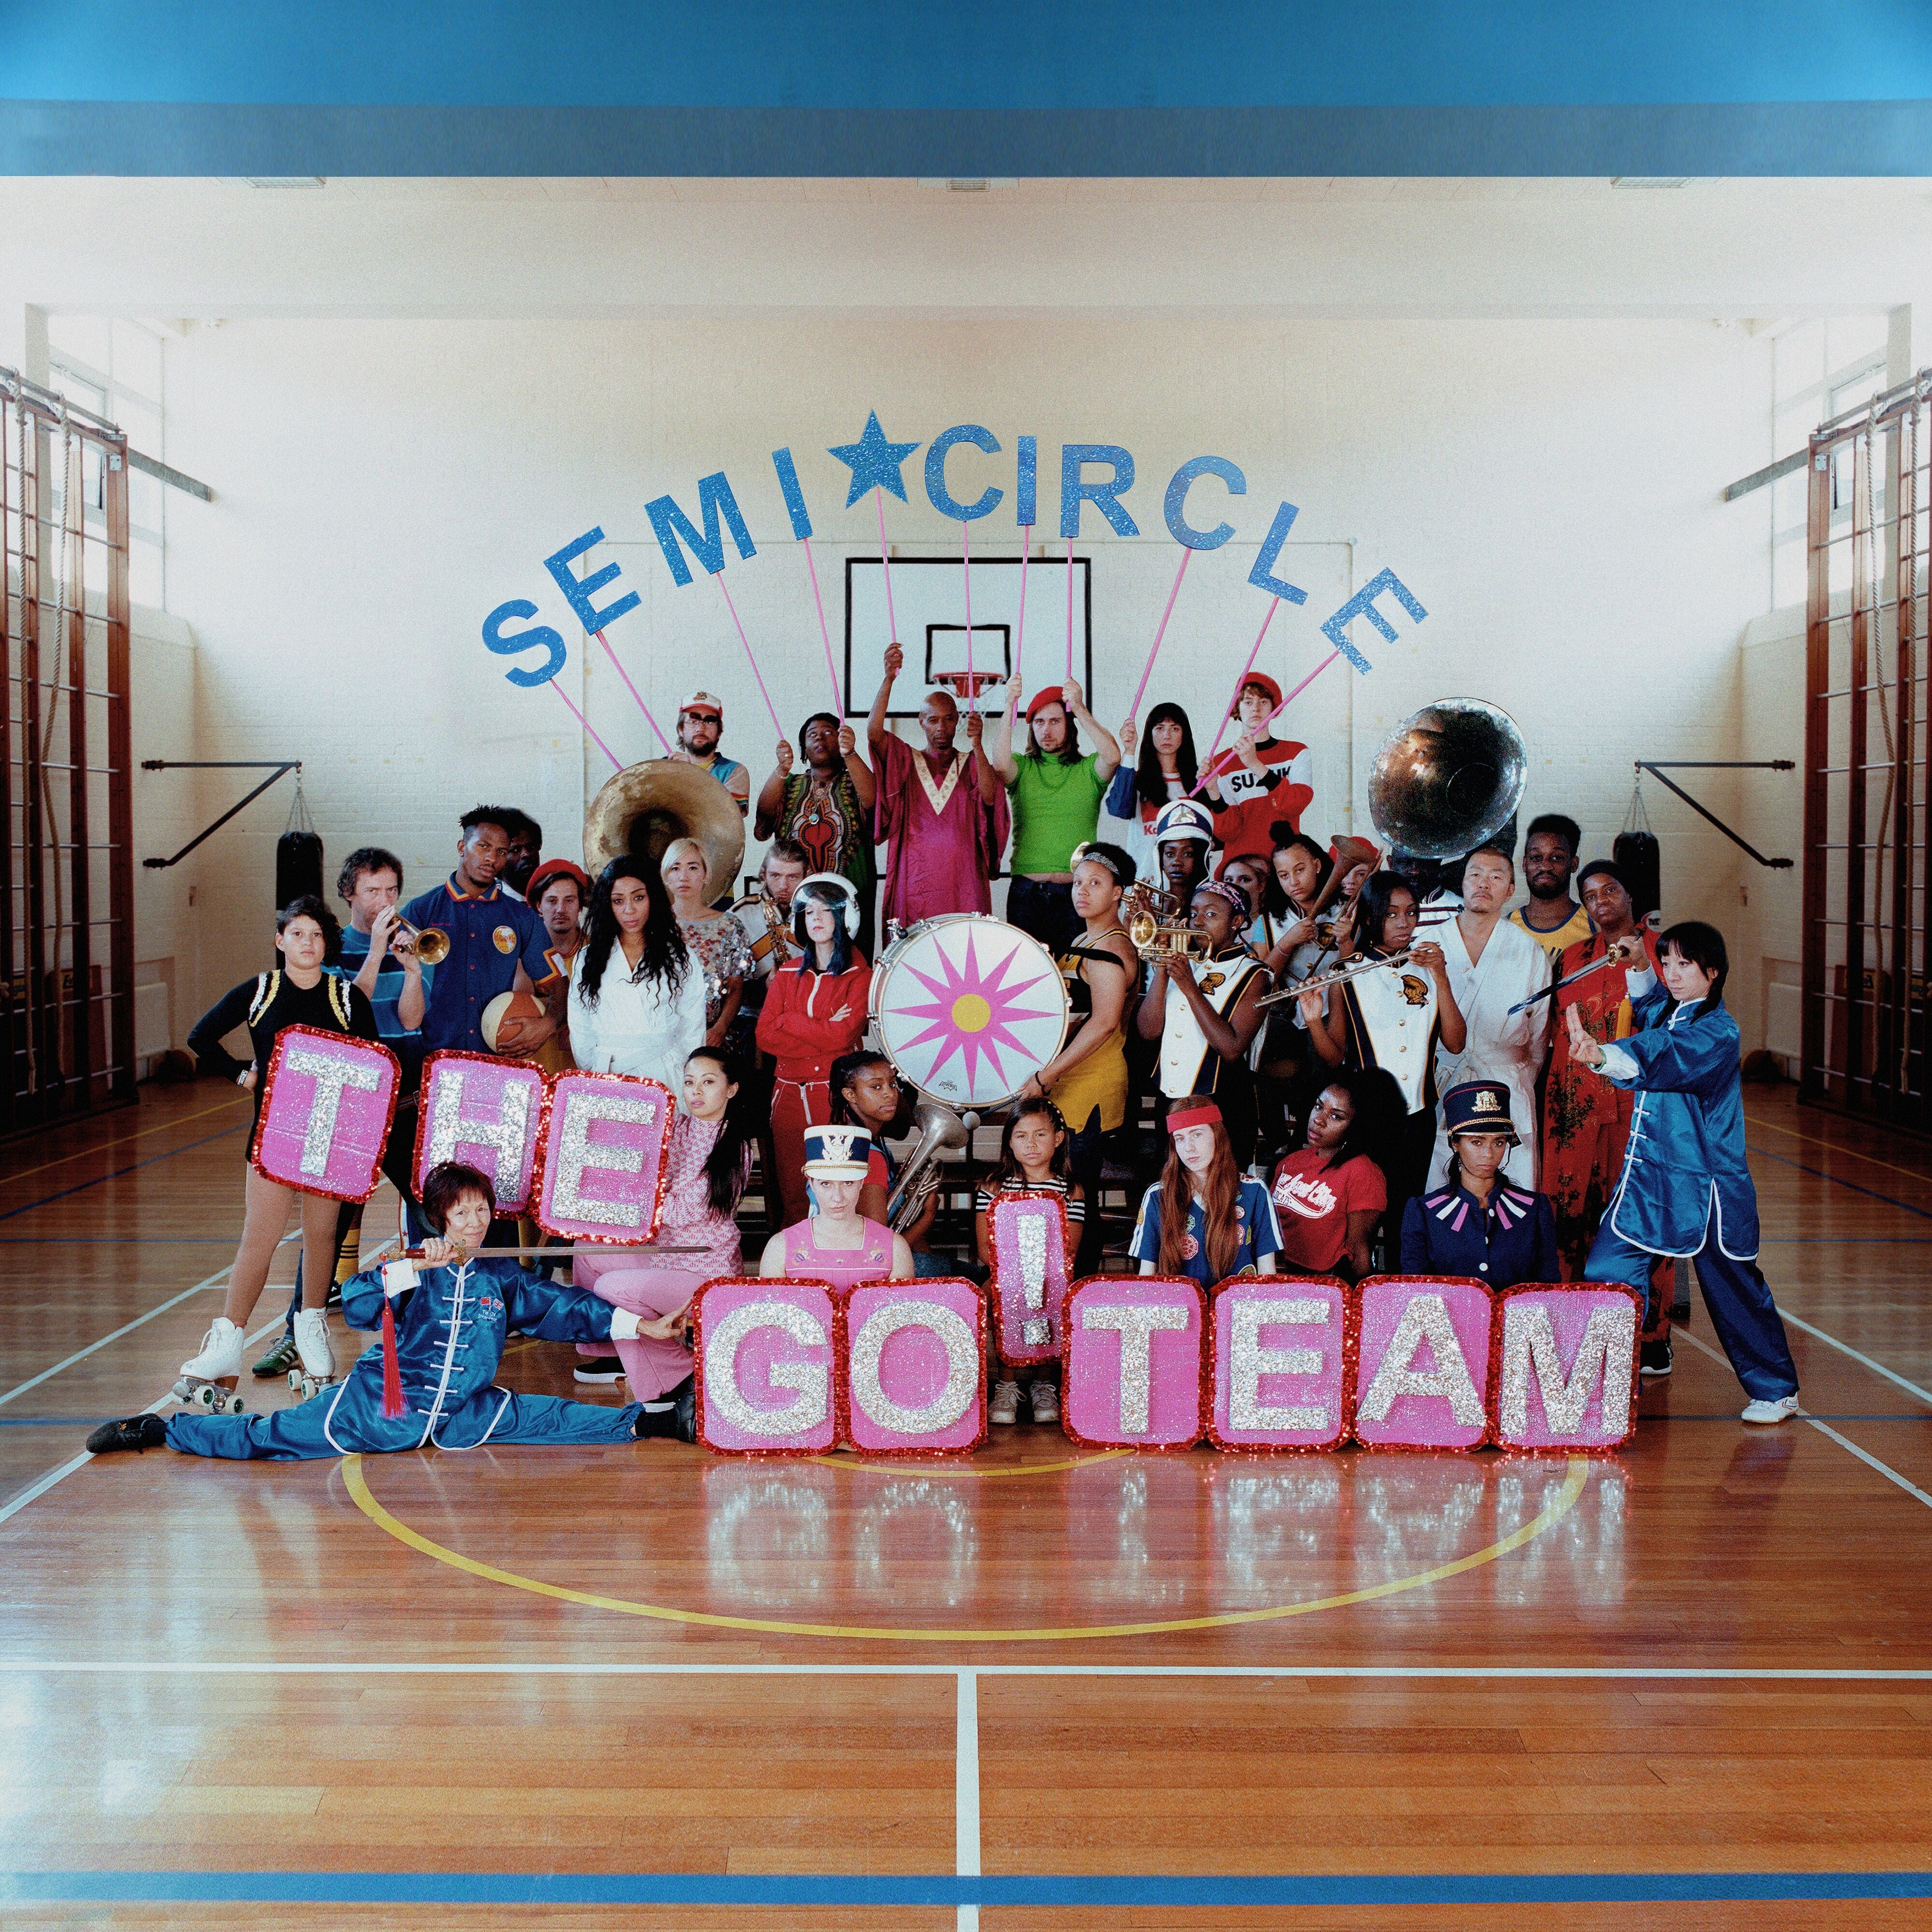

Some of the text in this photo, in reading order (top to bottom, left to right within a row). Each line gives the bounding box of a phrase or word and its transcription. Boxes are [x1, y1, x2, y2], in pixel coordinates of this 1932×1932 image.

[482, 425, 1429, 687] SEMI CIRCLE
[286, 1049, 656, 1228] THE
[1082, 1294, 1635, 1435] TEAM
